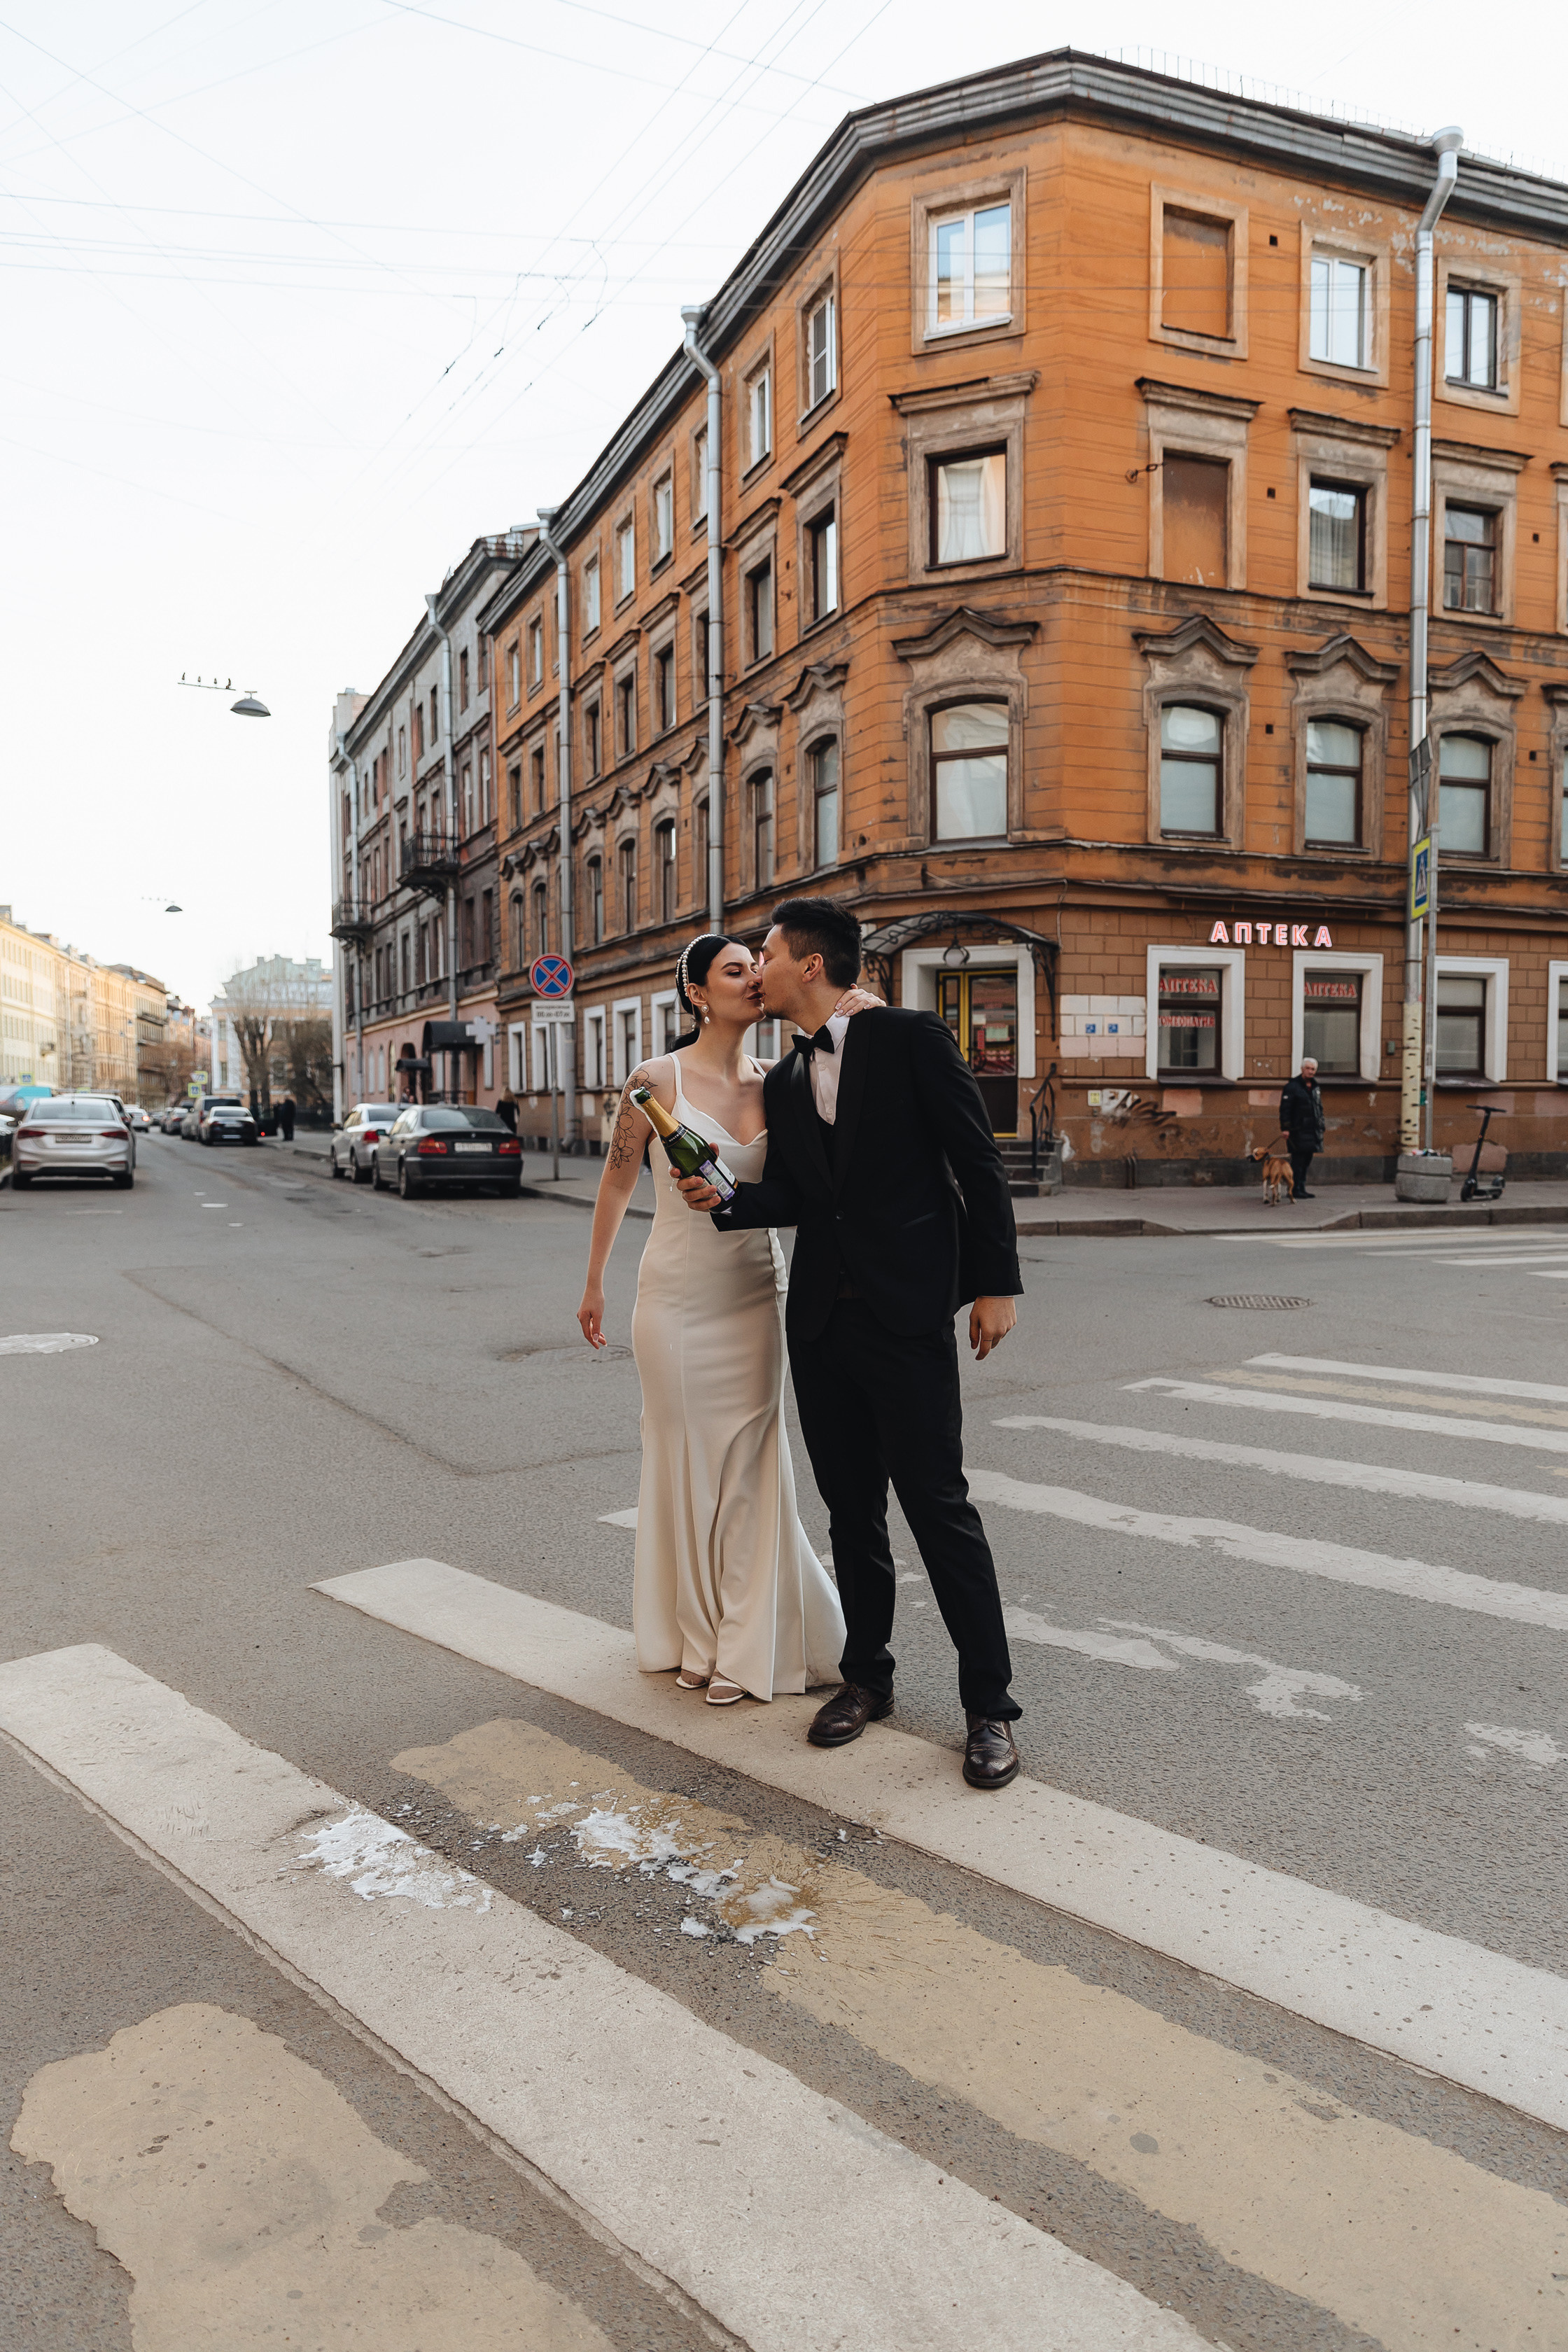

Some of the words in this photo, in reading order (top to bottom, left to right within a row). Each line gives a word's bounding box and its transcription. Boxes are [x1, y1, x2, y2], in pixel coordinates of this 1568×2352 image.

[1210, 920, 1333, 947] АПТЕКА
[1158, 978, 1219, 993] АПТЕКА
[1304, 981, 1357, 998] АПТЕКА
